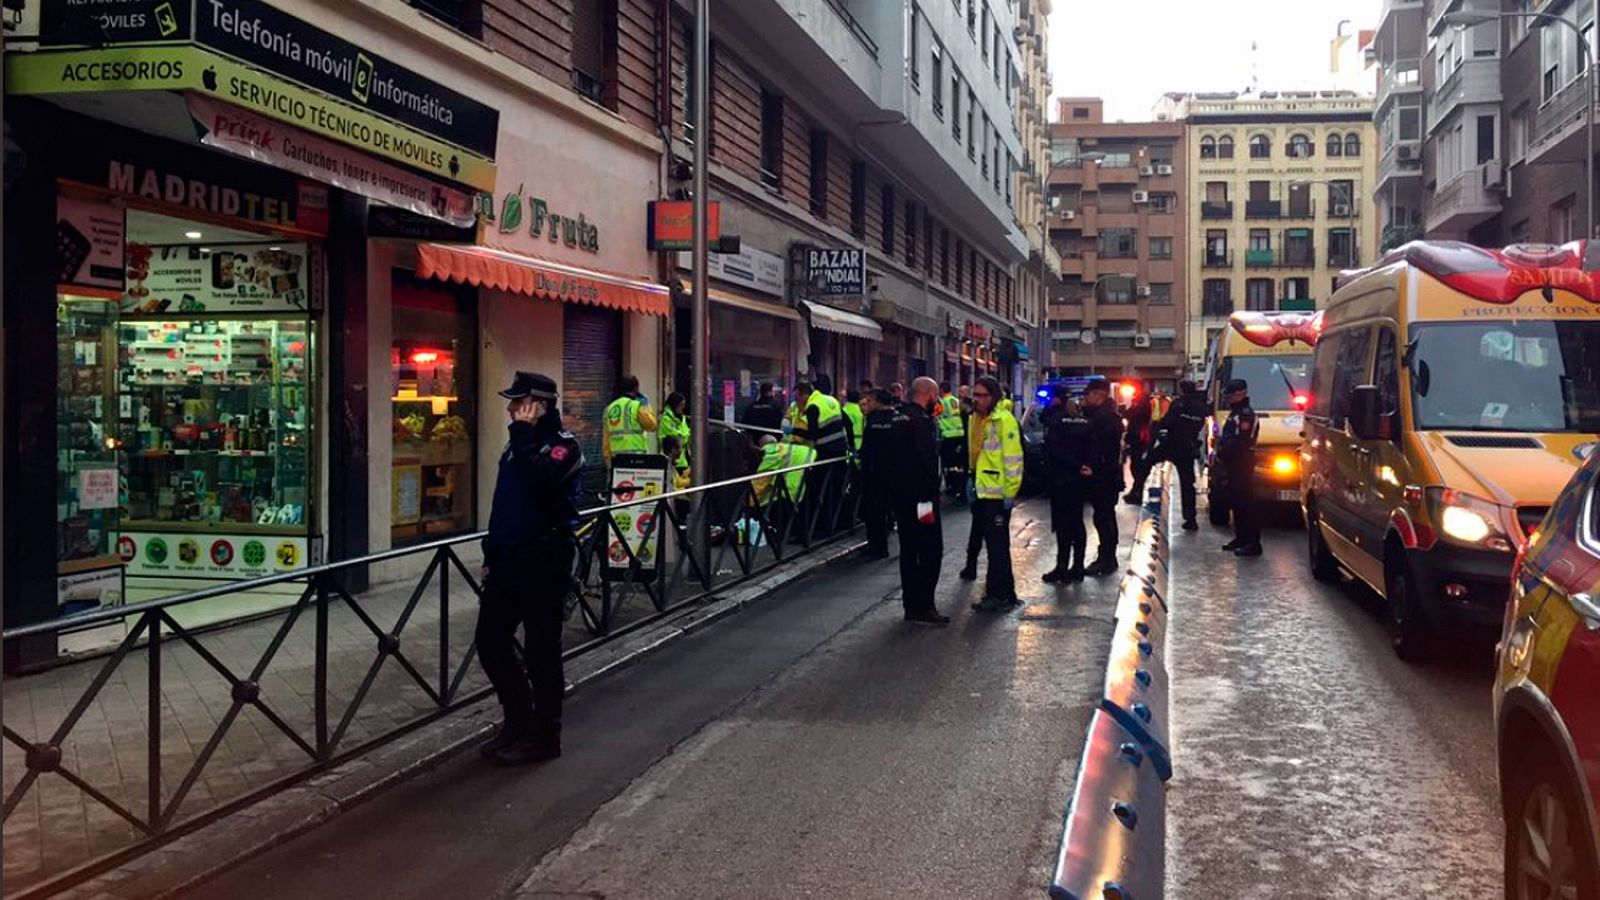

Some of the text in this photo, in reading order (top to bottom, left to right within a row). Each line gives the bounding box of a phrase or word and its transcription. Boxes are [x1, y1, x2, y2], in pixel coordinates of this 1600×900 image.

[90, 12, 147, 29] ÓVILES
[61, 60, 183, 82] ACCESORIOS
[209, 0, 301, 62] Telefonía
[305, 49, 352, 84] móvil
[372, 71, 454, 125] informática
[229, 76, 444, 169] SERVICIO TÉCNICO DE MÓVILES
[109, 160, 296, 226] MADRIDTEL
[529, 195, 600, 254] Fruta
[810, 250, 860, 268] BAZAR
[1510, 268, 1594, 286] SAMUR
